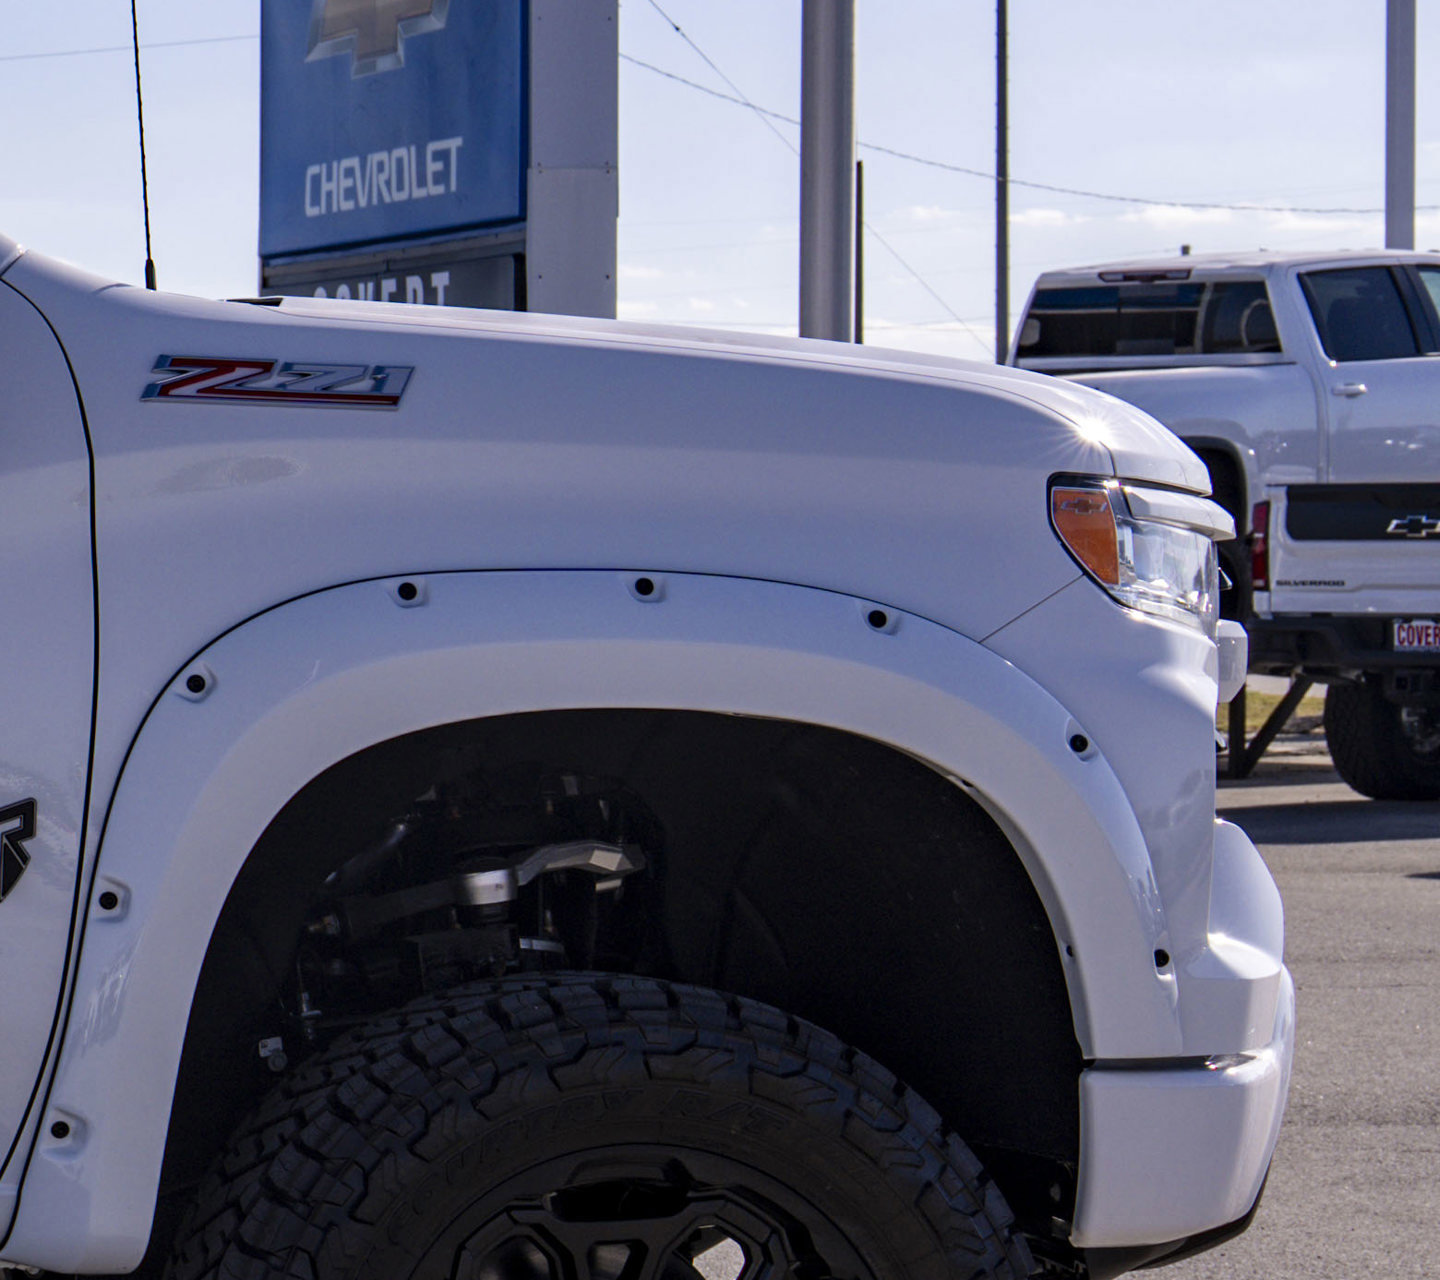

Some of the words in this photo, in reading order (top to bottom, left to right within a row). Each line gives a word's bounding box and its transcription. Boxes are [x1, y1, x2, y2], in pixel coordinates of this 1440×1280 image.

[305, 136, 463, 217] CHEVROLET
[140, 353, 416, 411] Z71
[1276, 579, 1345, 587] SILVERADO
